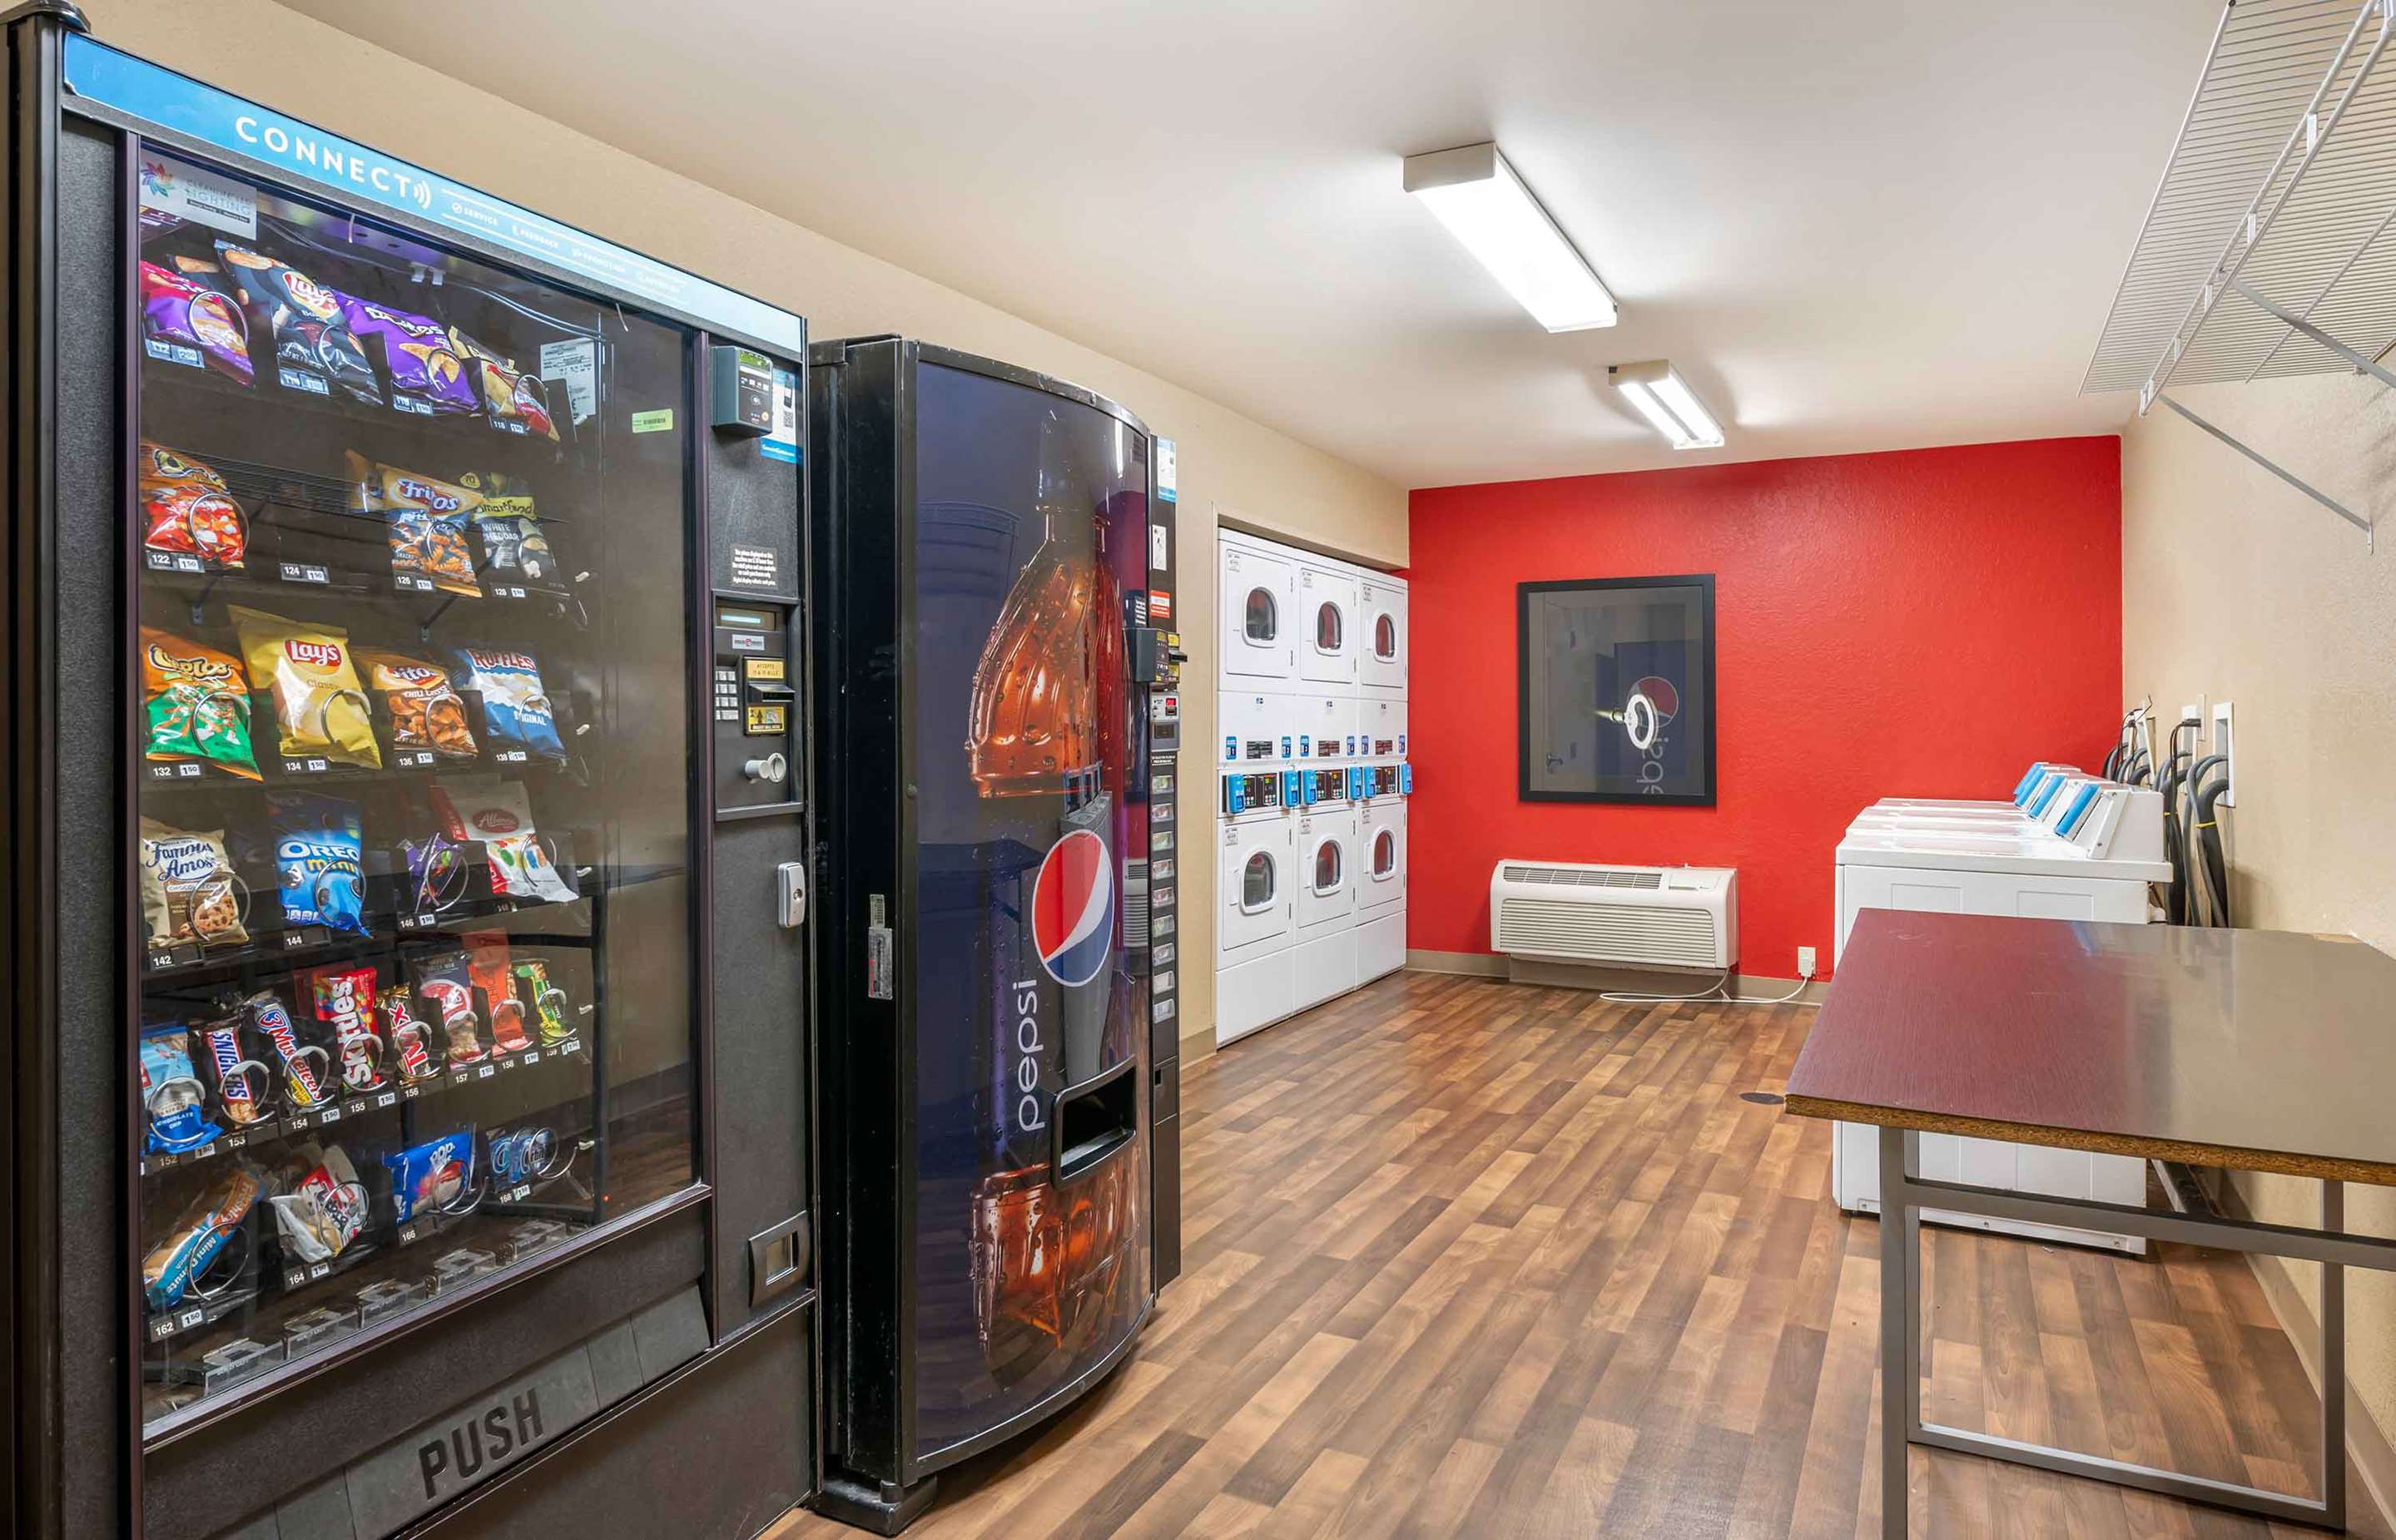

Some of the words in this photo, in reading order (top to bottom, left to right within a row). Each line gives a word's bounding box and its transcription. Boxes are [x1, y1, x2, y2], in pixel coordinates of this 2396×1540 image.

[235, 116, 408, 199] CONNECT
[151, 554, 171, 564] 122
[284, 566, 300, 576] 124
[290, 640, 340, 666] Lay's
[513, 710, 547, 726] OIGINAL
[152, 766, 172, 777] 132
[182, 766, 198, 775] 150
[285, 761, 301, 771] 134
[146, 841, 214, 868] Famous
[280, 841, 360, 860] OREO
[400, 919, 414, 928] 146
[286, 936, 302, 946] 144
[153, 955, 172, 967] 142
[259, 1011, 284, 1027] 3
[1013, 978, 1045, 1131] pepsi
[455, 1073, 469, 1083] 157
[404, 1087, 419, 1098] 156
[350, 1104, 365, 1113] 155
[292, 1119, 308, 1129] 154
[228, 1136, 246, 1147] 153
[160, 1156, 178, 1166] 152
[402, 1231, 416, 1242] 166
[166, 1256, 198, 1295] Dnuts
[289, 1272, 305, 1285] 164
[155, 1321, 175, 1336] 162
[185, 1312, 201, 1325] 150
[419, 1387, 544, 1500] PUSH
